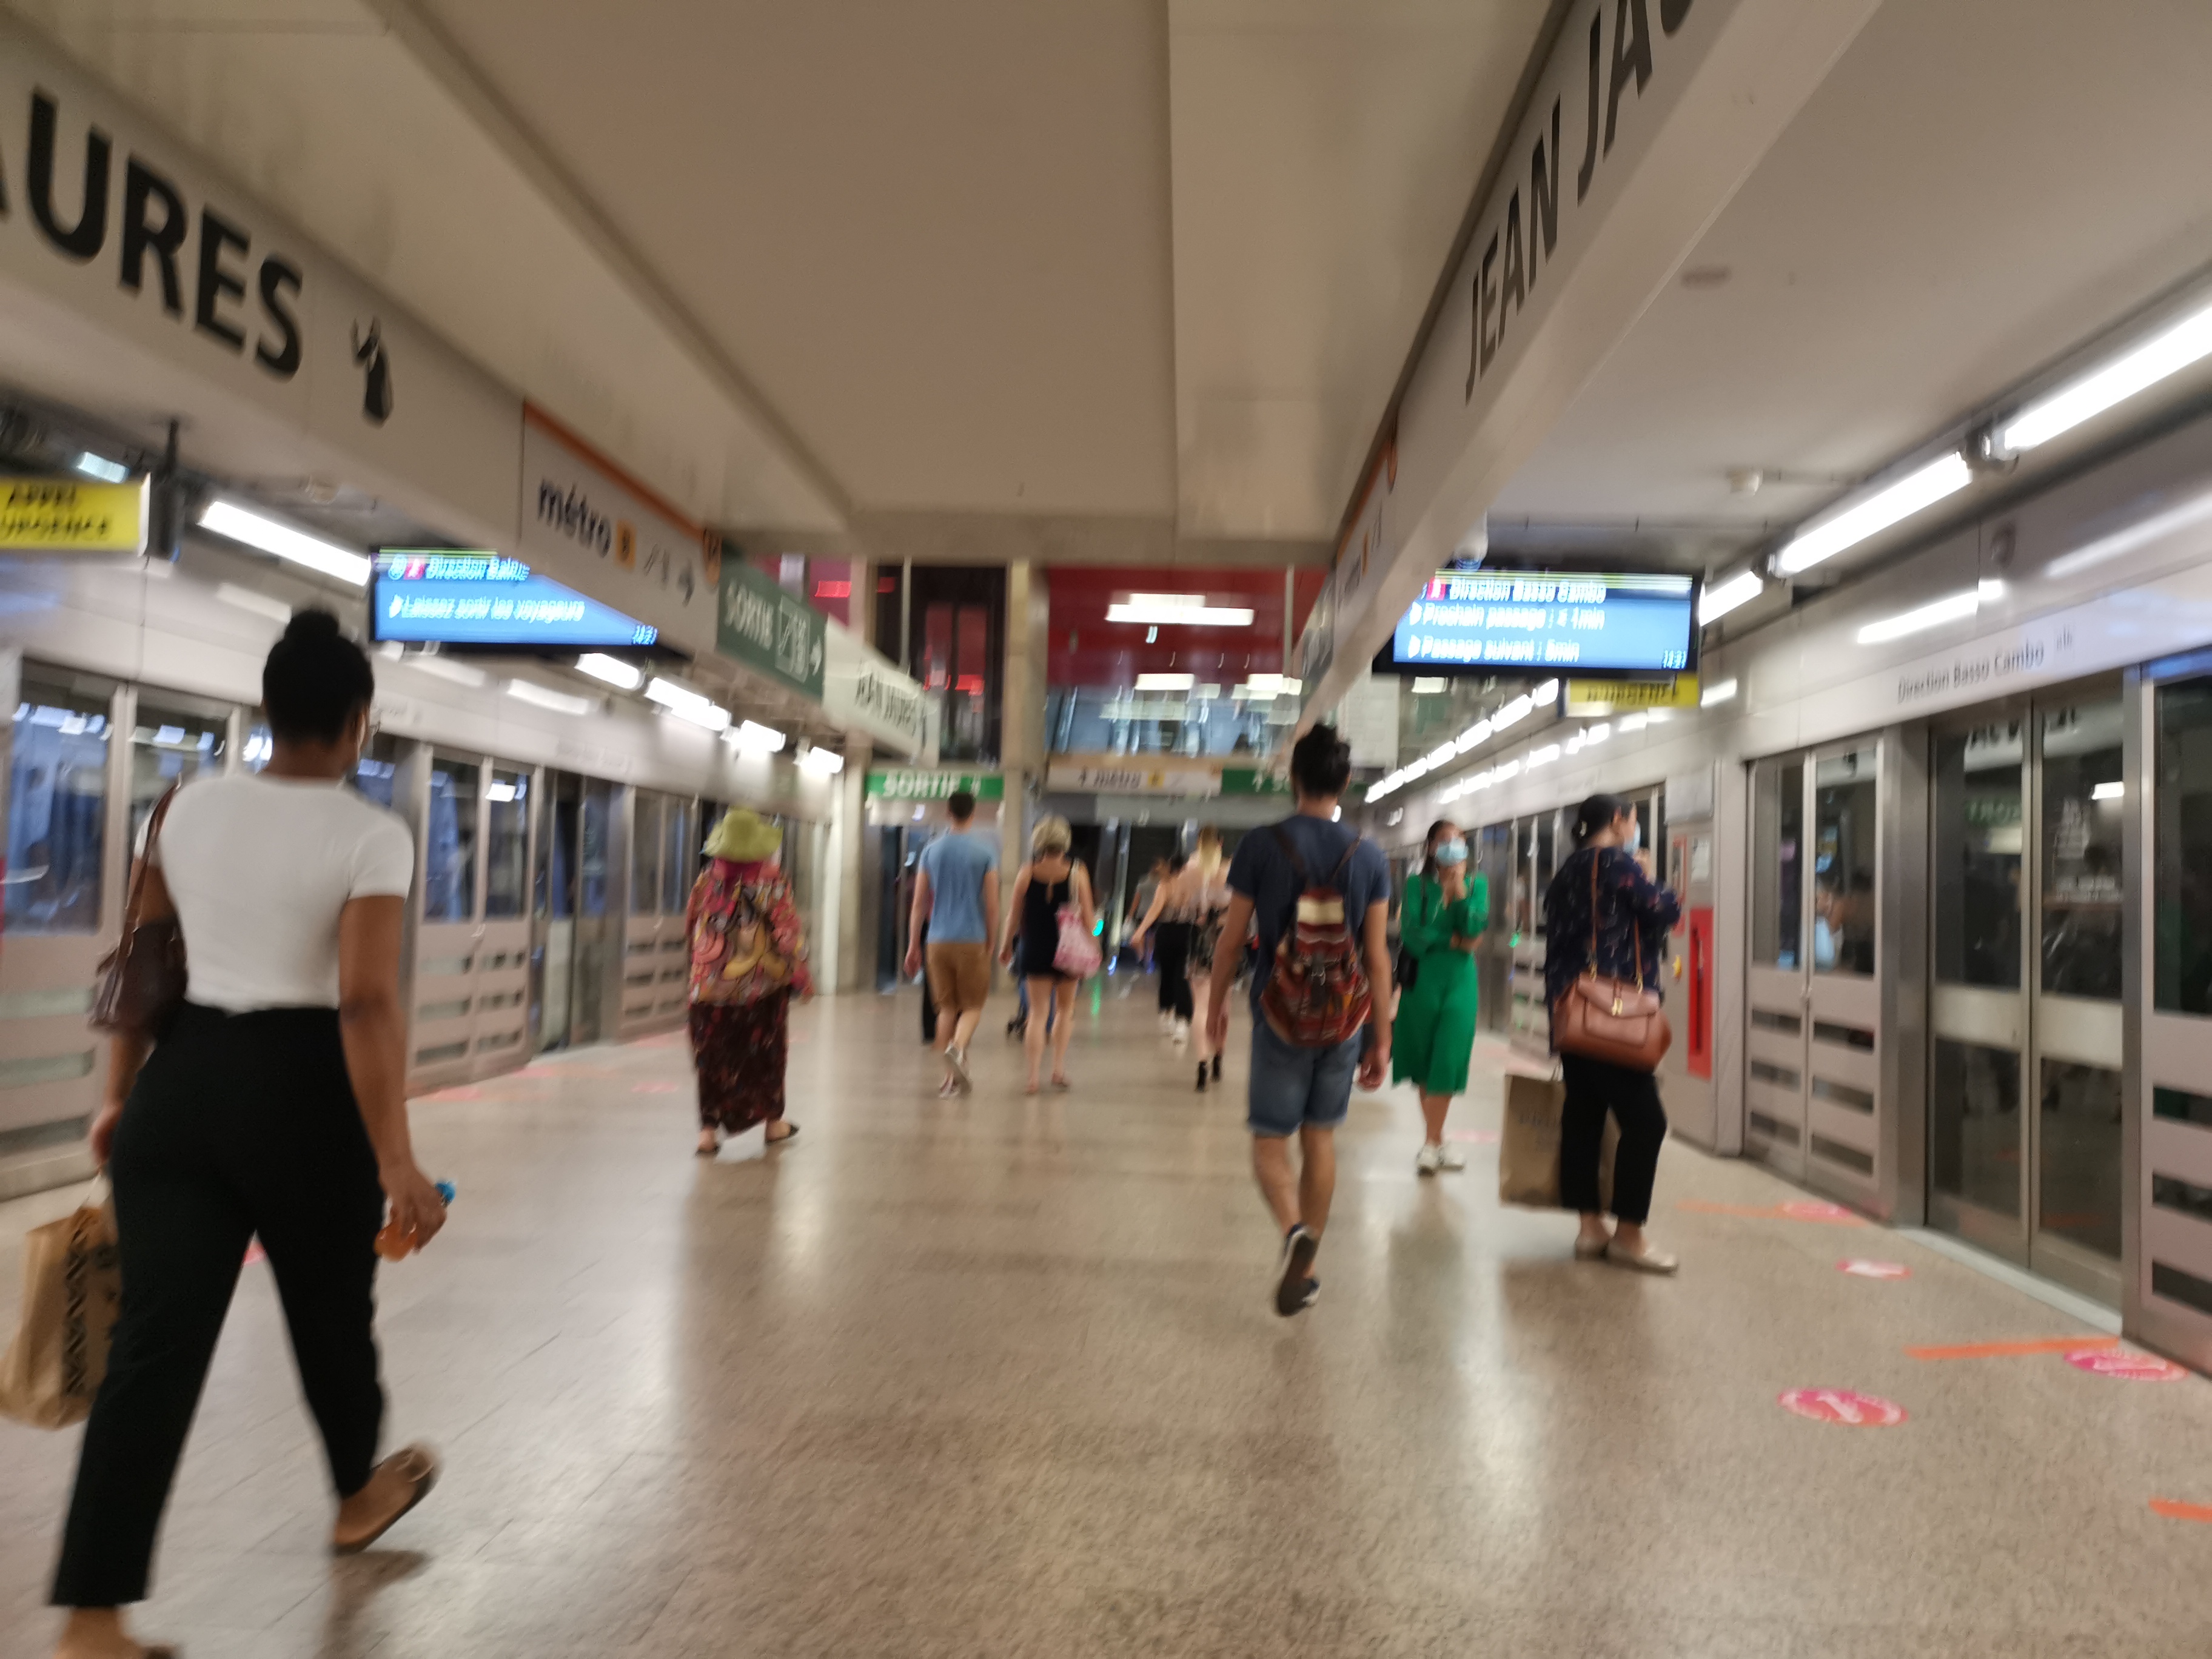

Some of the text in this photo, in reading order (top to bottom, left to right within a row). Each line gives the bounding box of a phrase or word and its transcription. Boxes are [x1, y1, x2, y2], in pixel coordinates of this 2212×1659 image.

[1465, 0, 1695, 407] JEAN JA
[0, 86, 303, 382] URES
[538, 479, 611, 558] métro
[426, 554, 487, 580] Direction
[401, 594, 455, 619] Laissez
[454, 596, 492, 620] sortir
[514, 598, 585, 623] voyageurs
[1449, 578, 1511, 601] Direction
[1512, 579, 1556, 603] Basso
[1557, 579, 1607, 604] Cambo
[724, 579, 774, 651] SORTIE
[1423, 602, 1485, 627] Prochain
[1486, 606, 1547, 631] passage
[1421, 635, 1483, 662] Passage
[1484, 637, 1535, 662] suivant
[1897, 669, 1949, 704] Direction
[1953, 657, 1990, 688] Basso
[1994, 638, 2045, 677] Cambo
